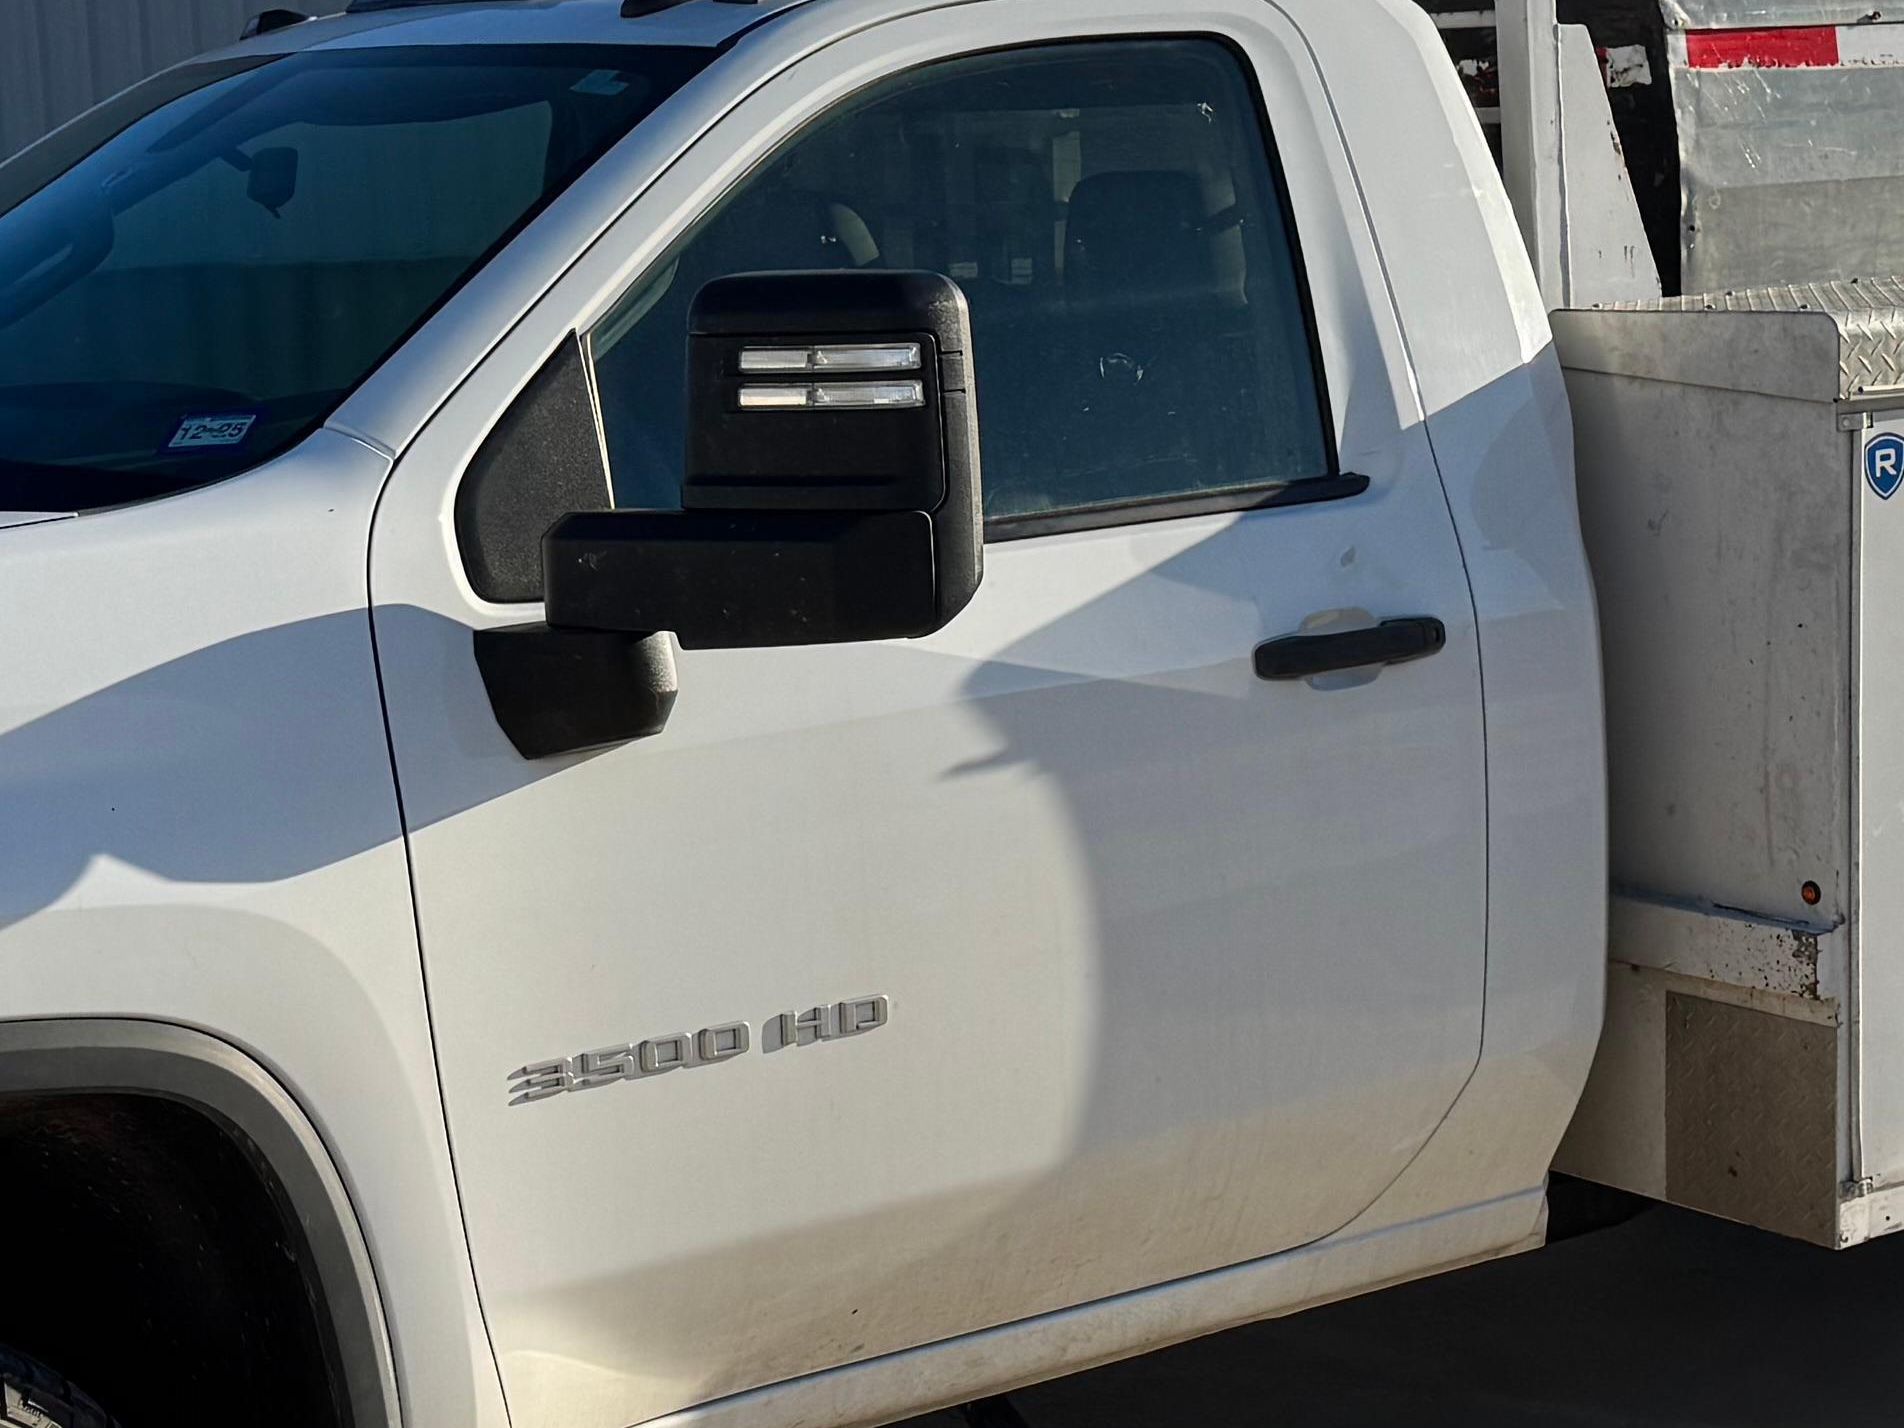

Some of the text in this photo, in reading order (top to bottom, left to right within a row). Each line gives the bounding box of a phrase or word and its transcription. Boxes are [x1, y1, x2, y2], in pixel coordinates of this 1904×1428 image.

[1874, 447, 1898, 478] R
[508, 994, 890, 1106] 3500 HD
